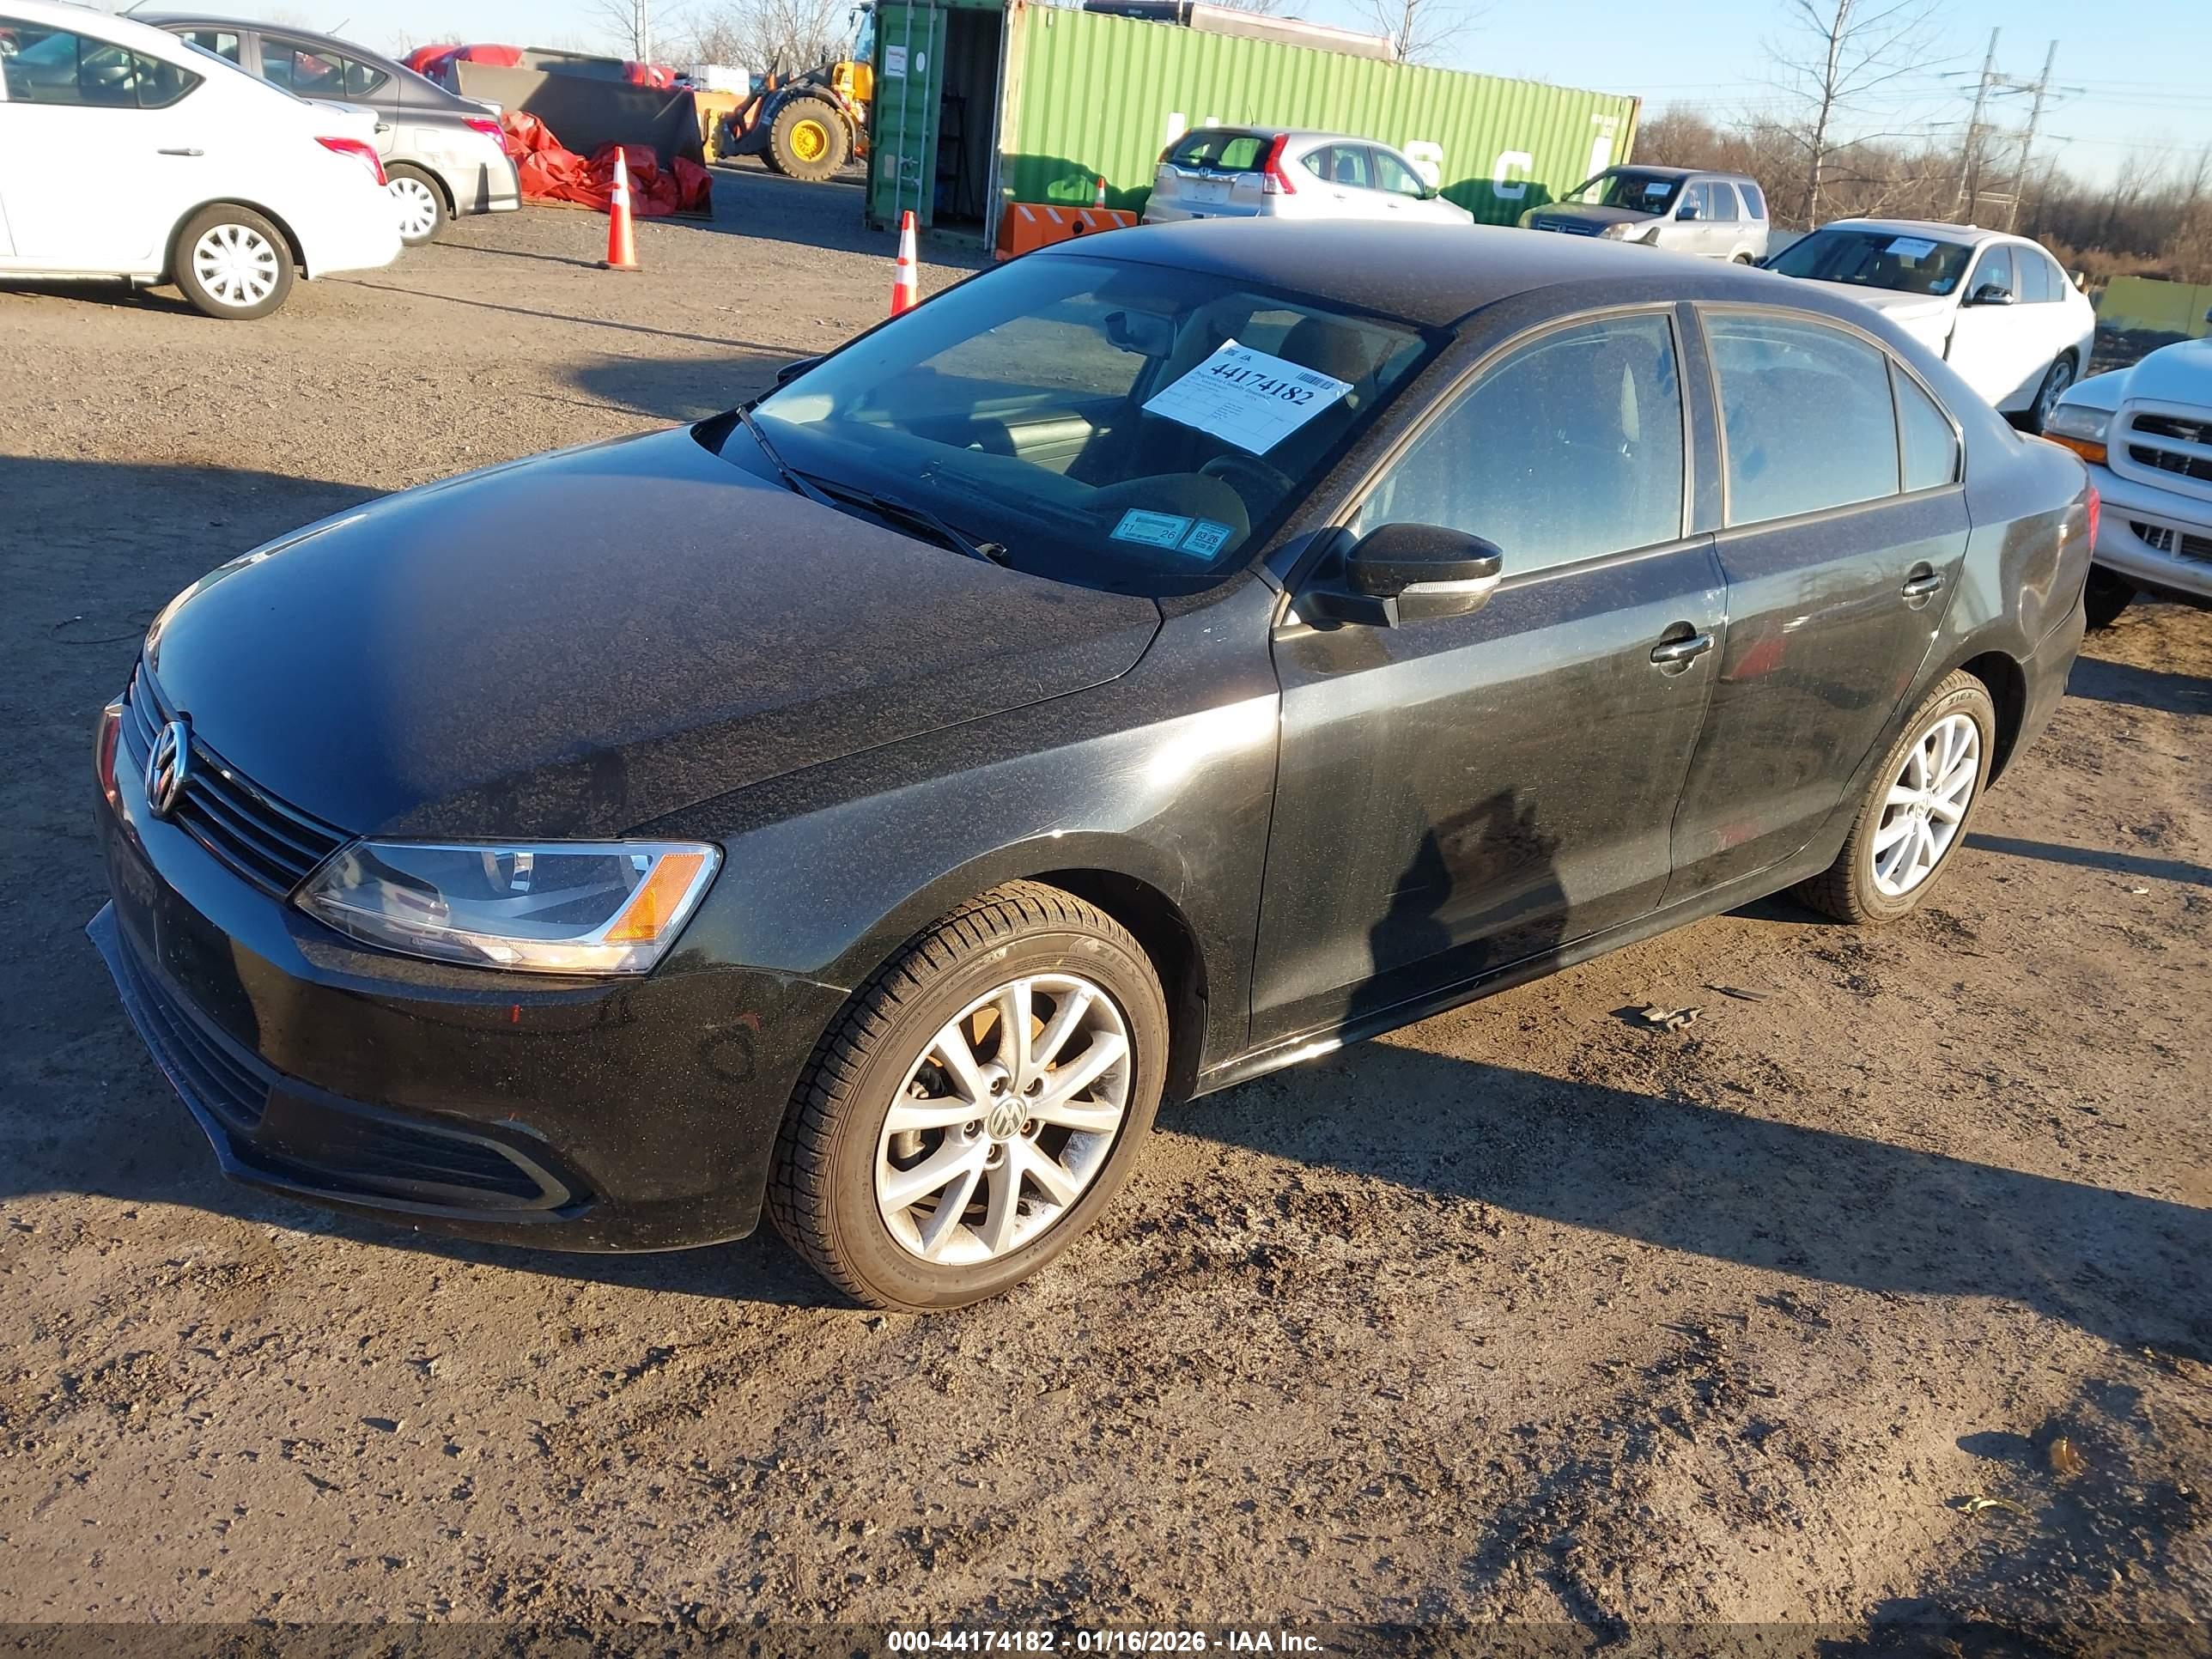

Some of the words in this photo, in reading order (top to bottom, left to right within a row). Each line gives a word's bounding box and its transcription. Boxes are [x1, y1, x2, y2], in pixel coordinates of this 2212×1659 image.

[1211, 362, 1315, 406] 44174182
[1122, 522, 1135, 532] 11
[1159, 529, 1176, 539] 26
[1195, 531, 1206, 540] 03
[1206, 533, 1220, 544] 26
[1094, 945, 1141, 981] ZIEX
